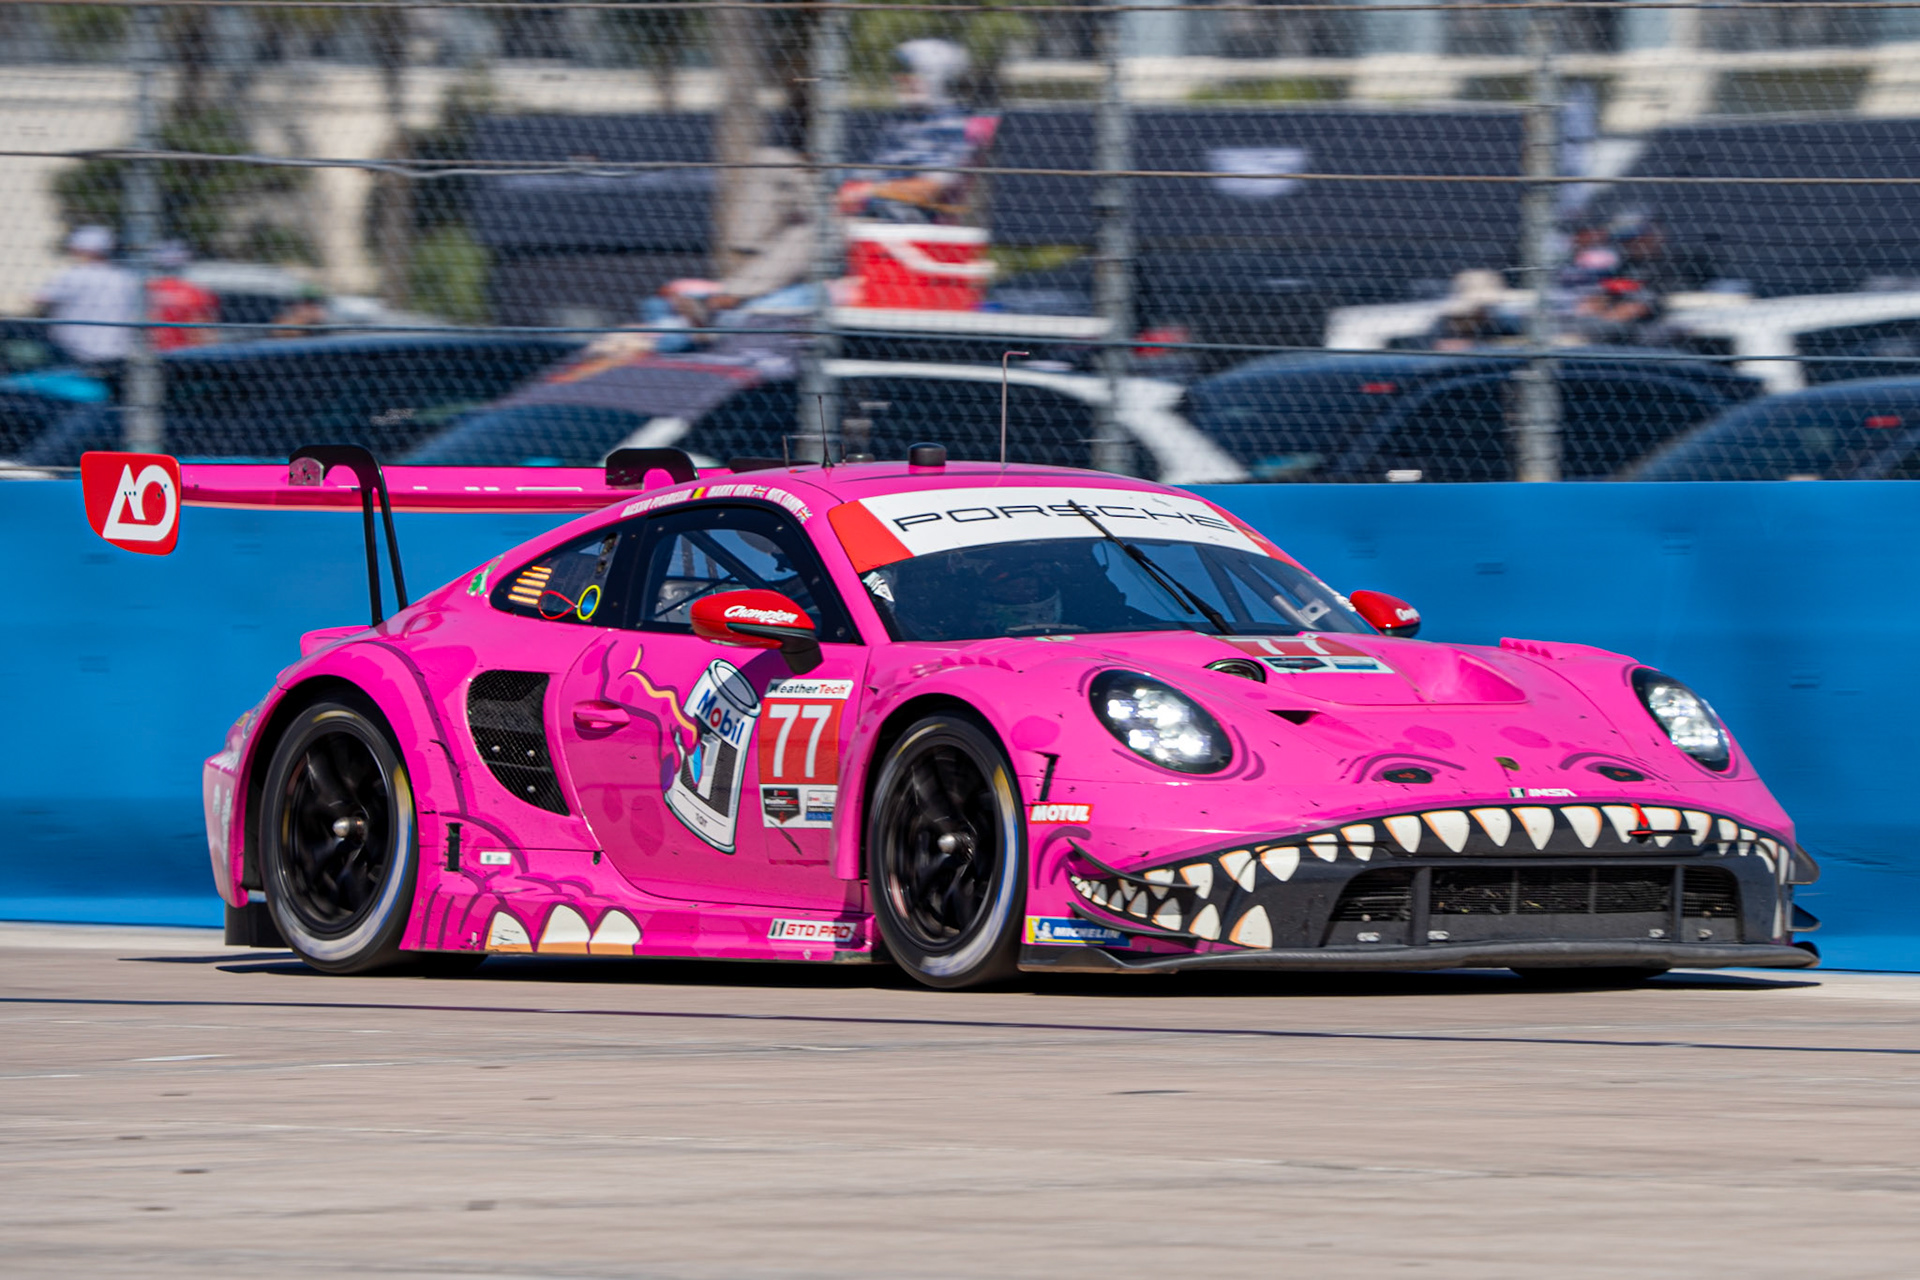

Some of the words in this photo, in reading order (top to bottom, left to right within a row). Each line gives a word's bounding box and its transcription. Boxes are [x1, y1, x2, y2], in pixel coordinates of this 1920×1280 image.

[893, 504, 1236, 533] PORSCHE
[724, 604, 798, 624] Champion
[1226, 638, 1332, 655] 77
[768, 683, 847, 694] WeatherTech
[697, 688, 745, 745] Mobil
[769, 704, 833, 778] 77
[1031, 804, 1090, 822] MOTUL
[785, 923, 816, 937] GTD
[818, 925, 851, 939] PRO
[1053, 926, 1121, 940] MICHELIN
